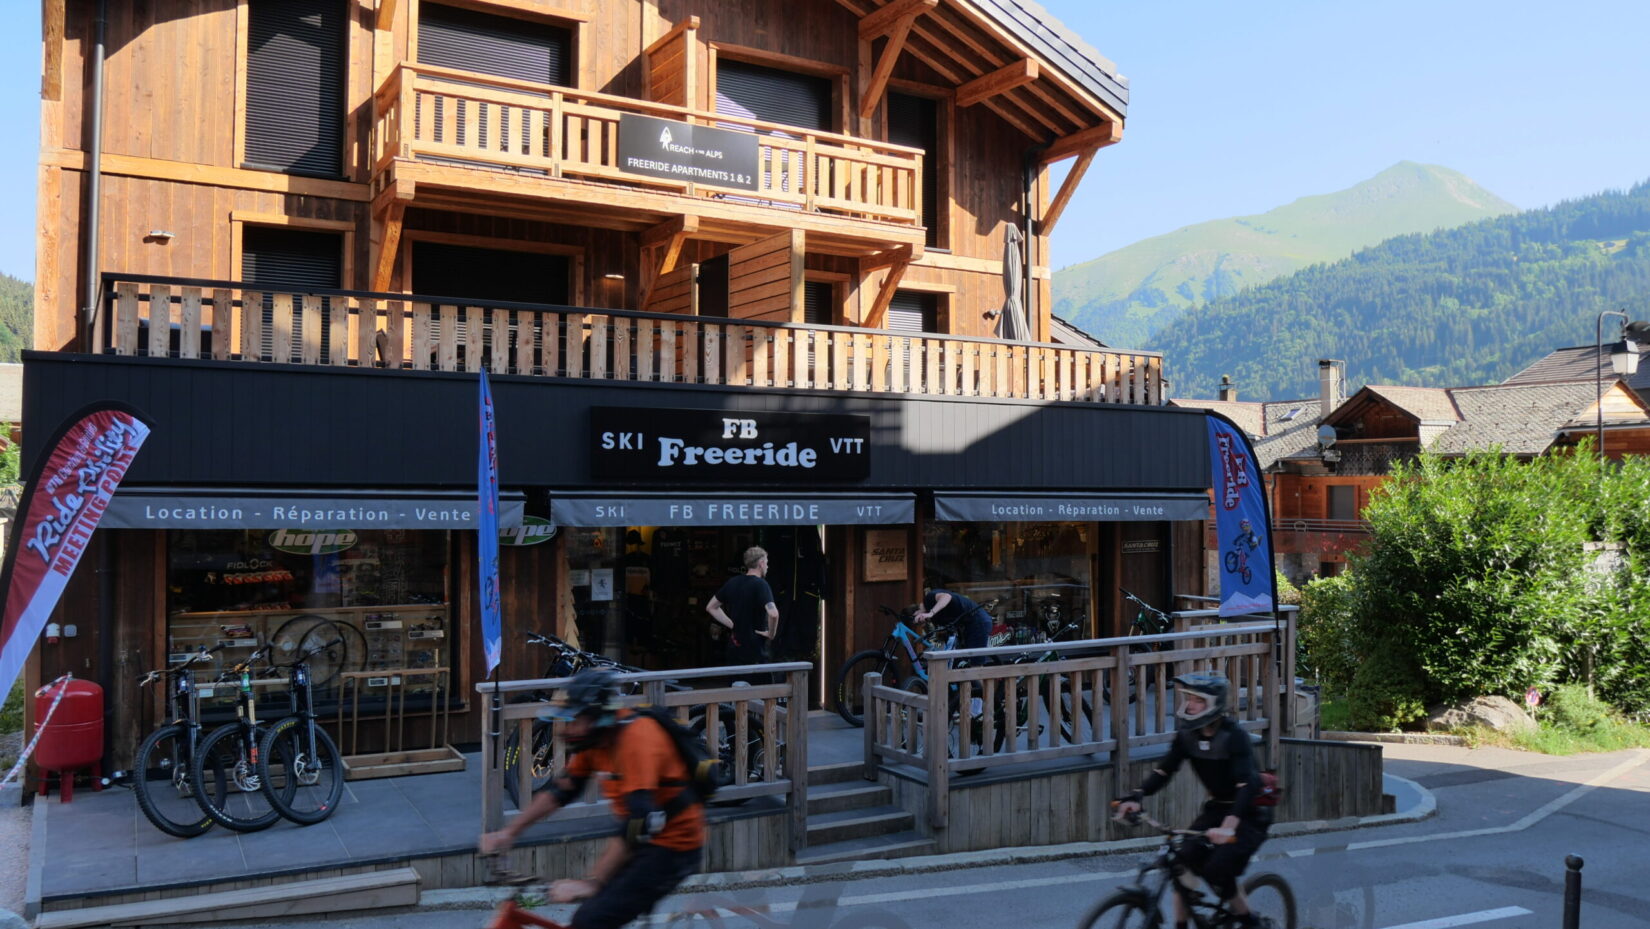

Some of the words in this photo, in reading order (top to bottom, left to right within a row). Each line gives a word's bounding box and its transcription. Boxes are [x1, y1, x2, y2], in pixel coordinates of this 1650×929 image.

[669, 143, 694, 155] REACH
[705, 150, 723, 159] ALPS
[628, 157, 670, 172] FREERIDE
[671, 165, 728, 181] APARTMENTS
[730, 173, 735, 182] 1
[737, 174, 744, 183] &
[745, 176, 751, 184] 2
[722, 418, 758, 439] FB
[602, 432, 643, 450] SKI
[830, 438, 864, 454] VTT
[658, 436, 817, 468] Freeride
[53, 494, 108, 577] MEETING
[101, 445, 138, 497] POINT
[146, 505, 242, 520] Location
[273, 505, 389, 524] Réparation
[415, 508, 471, 521] Vente
[596, 506, 624, 518] SKI
[670, 505, 693, 519] FB
[708, 504, 819, 520] FREERIDE
[857, 506, 882, 517] VTT
[992, 504, 1043, 516] Location
[1058, 504, 1119, 518] Réparation
[1133, 506, 1164, 516] Vente
[27, 495, 84, 565] Ride
[499, 525, 555, 545] ope
[273, 529, 355, 553] hope
[226, 558, 273, 570] FIDLOCK
